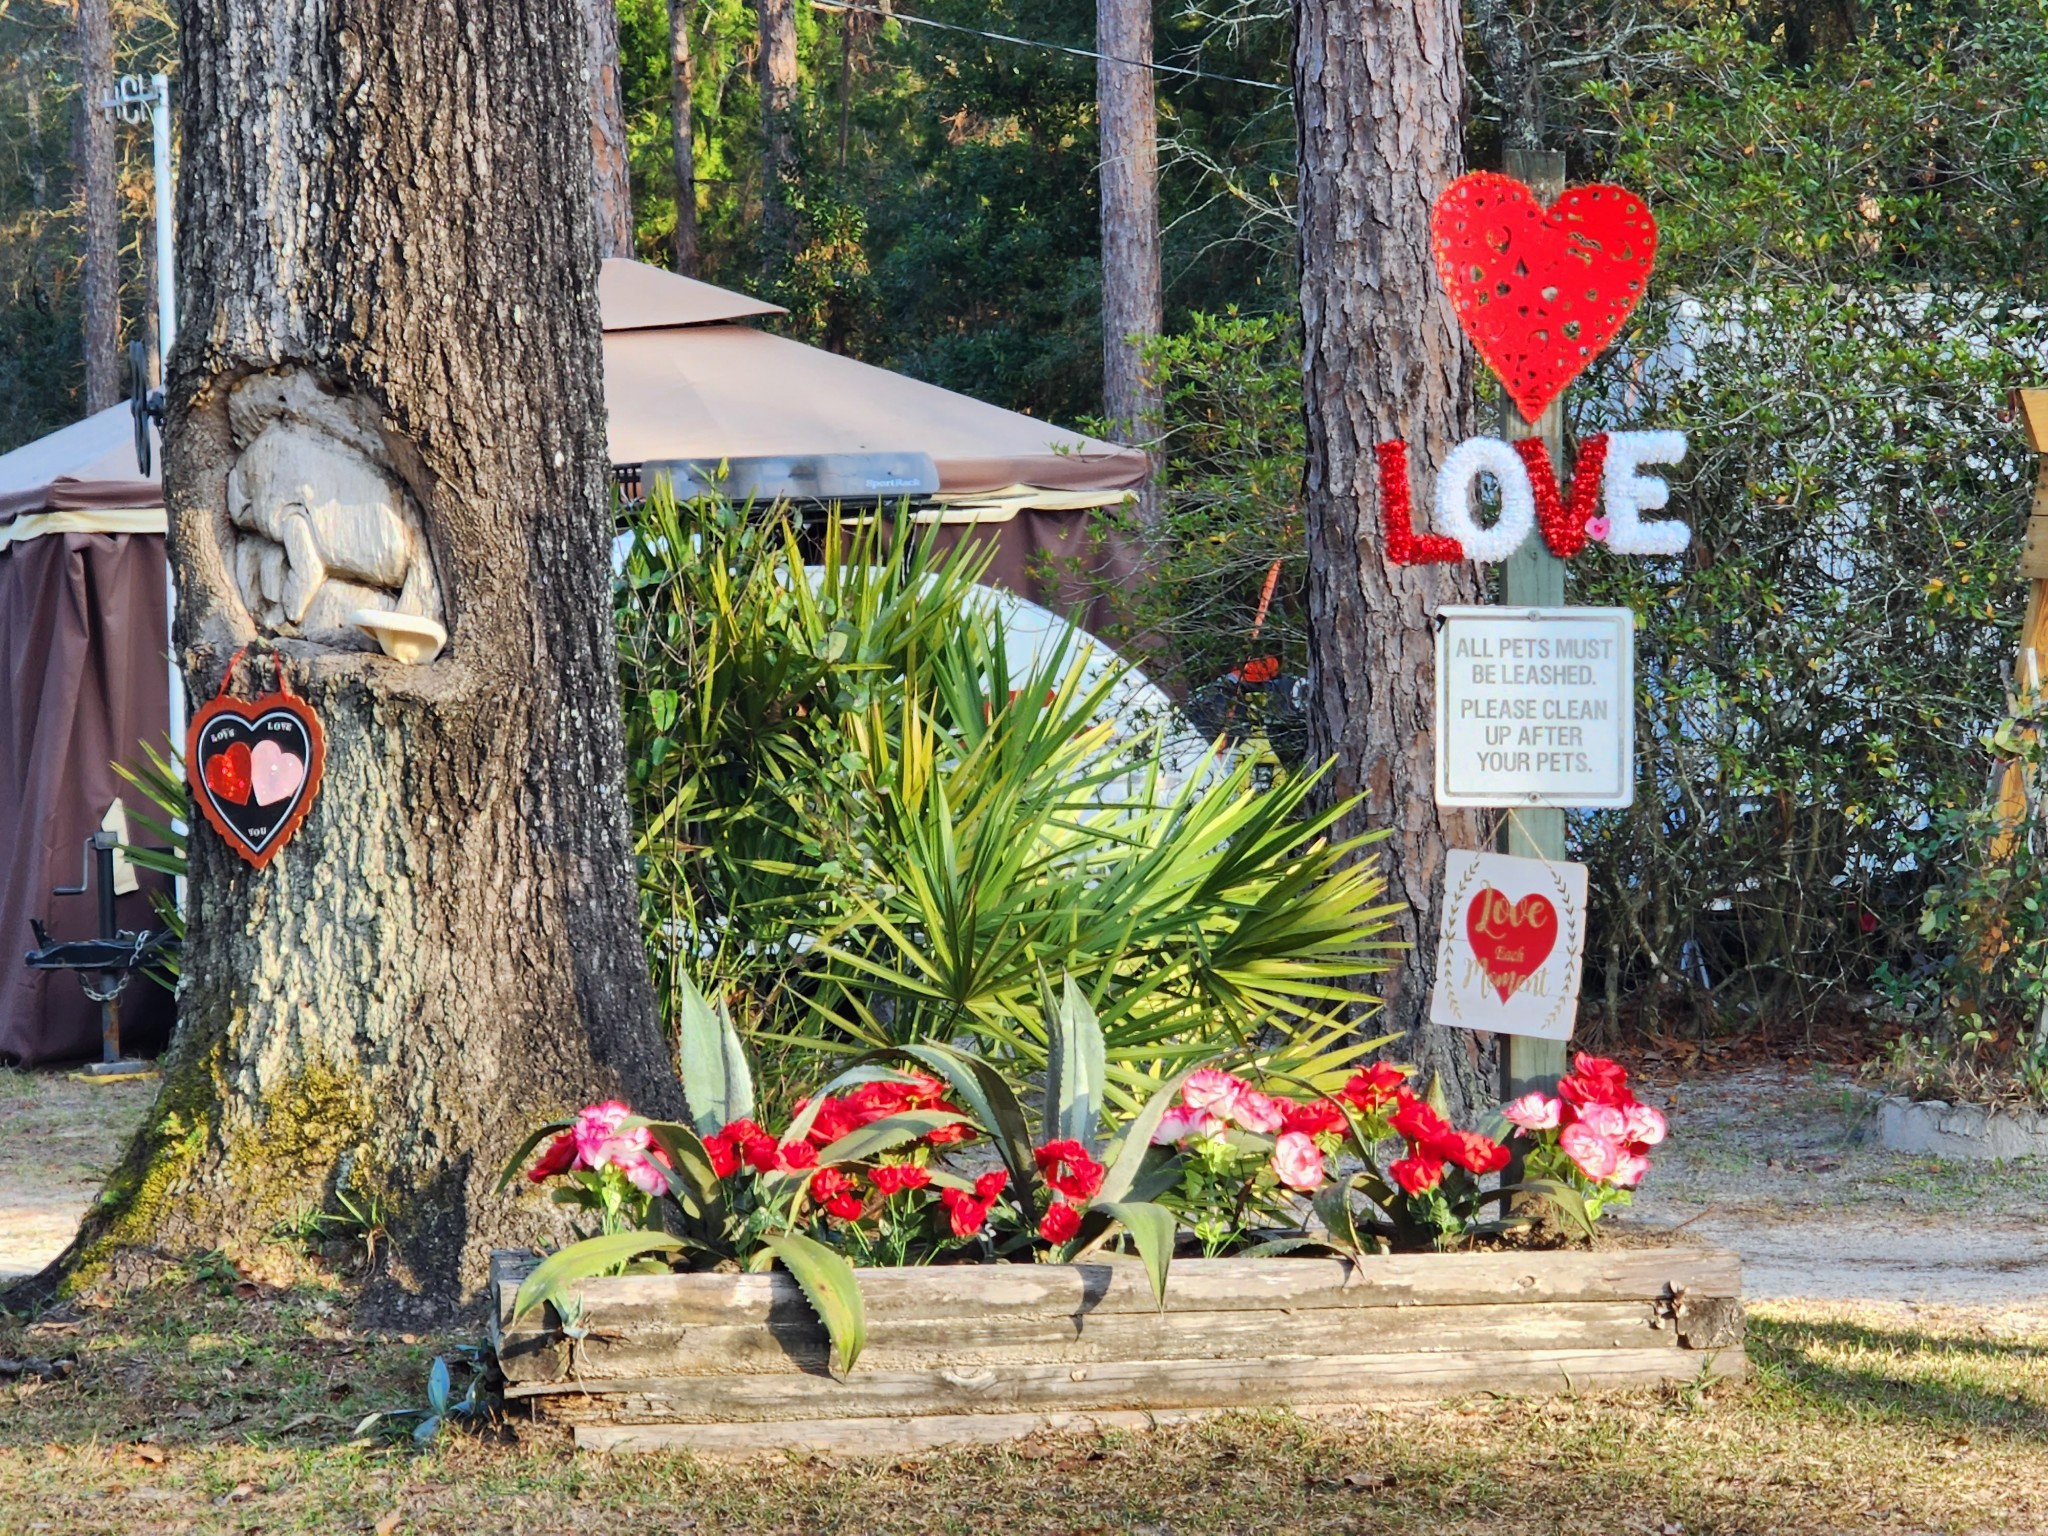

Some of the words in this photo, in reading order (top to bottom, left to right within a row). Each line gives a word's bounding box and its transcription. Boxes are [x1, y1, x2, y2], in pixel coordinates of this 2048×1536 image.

[1376, 429, 1691, 565] LOVE
[1456, 638, 1494, 659] ALL
[1500, 638, 1550, 659] PETS
[1556, 638, 1613, 660] MUST
[1472, 664, 1496, 685] BE
[1502, 664, 1597, 686] LEASHED.
[1461, 699, 1537, 720] PLEASE
[1542, 699, 1608, 721] CLEAN
[1485, 726, 1511, 746] UP
[1517, 726, 1583, 746] AFTER
[1477, 752, 1530, 772] YOUR
[1537, 752, 1593, 773] PETS.
[1475, 879, 1548, 940] Love
[1495, 945, 1525, 963] Each
[1462, 957, 1551, 999] Moment
